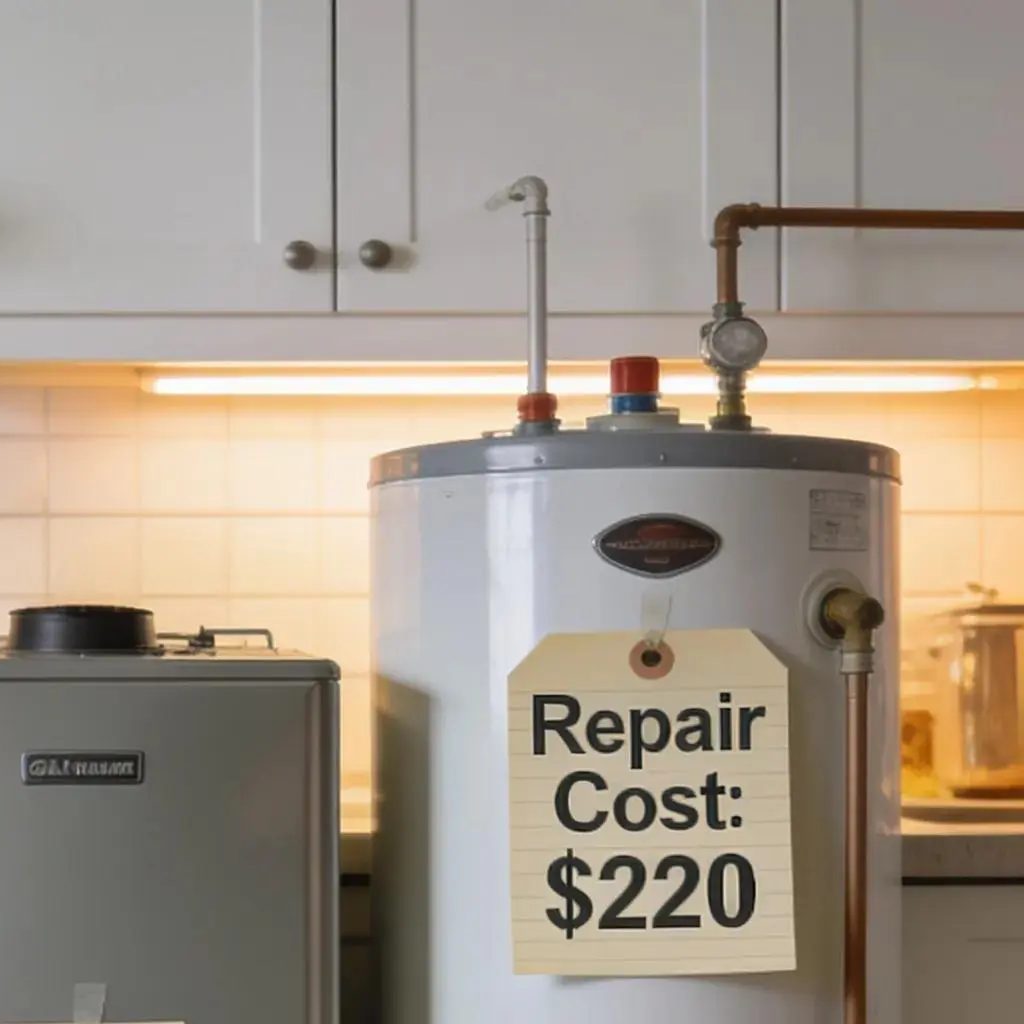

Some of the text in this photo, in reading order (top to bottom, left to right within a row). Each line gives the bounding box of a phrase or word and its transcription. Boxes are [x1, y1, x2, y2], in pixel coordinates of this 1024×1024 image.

[533, 692, 766, 770] Repair
[555, 770, 742, 832] Cost:
[546, 849, 756, 940] $220
